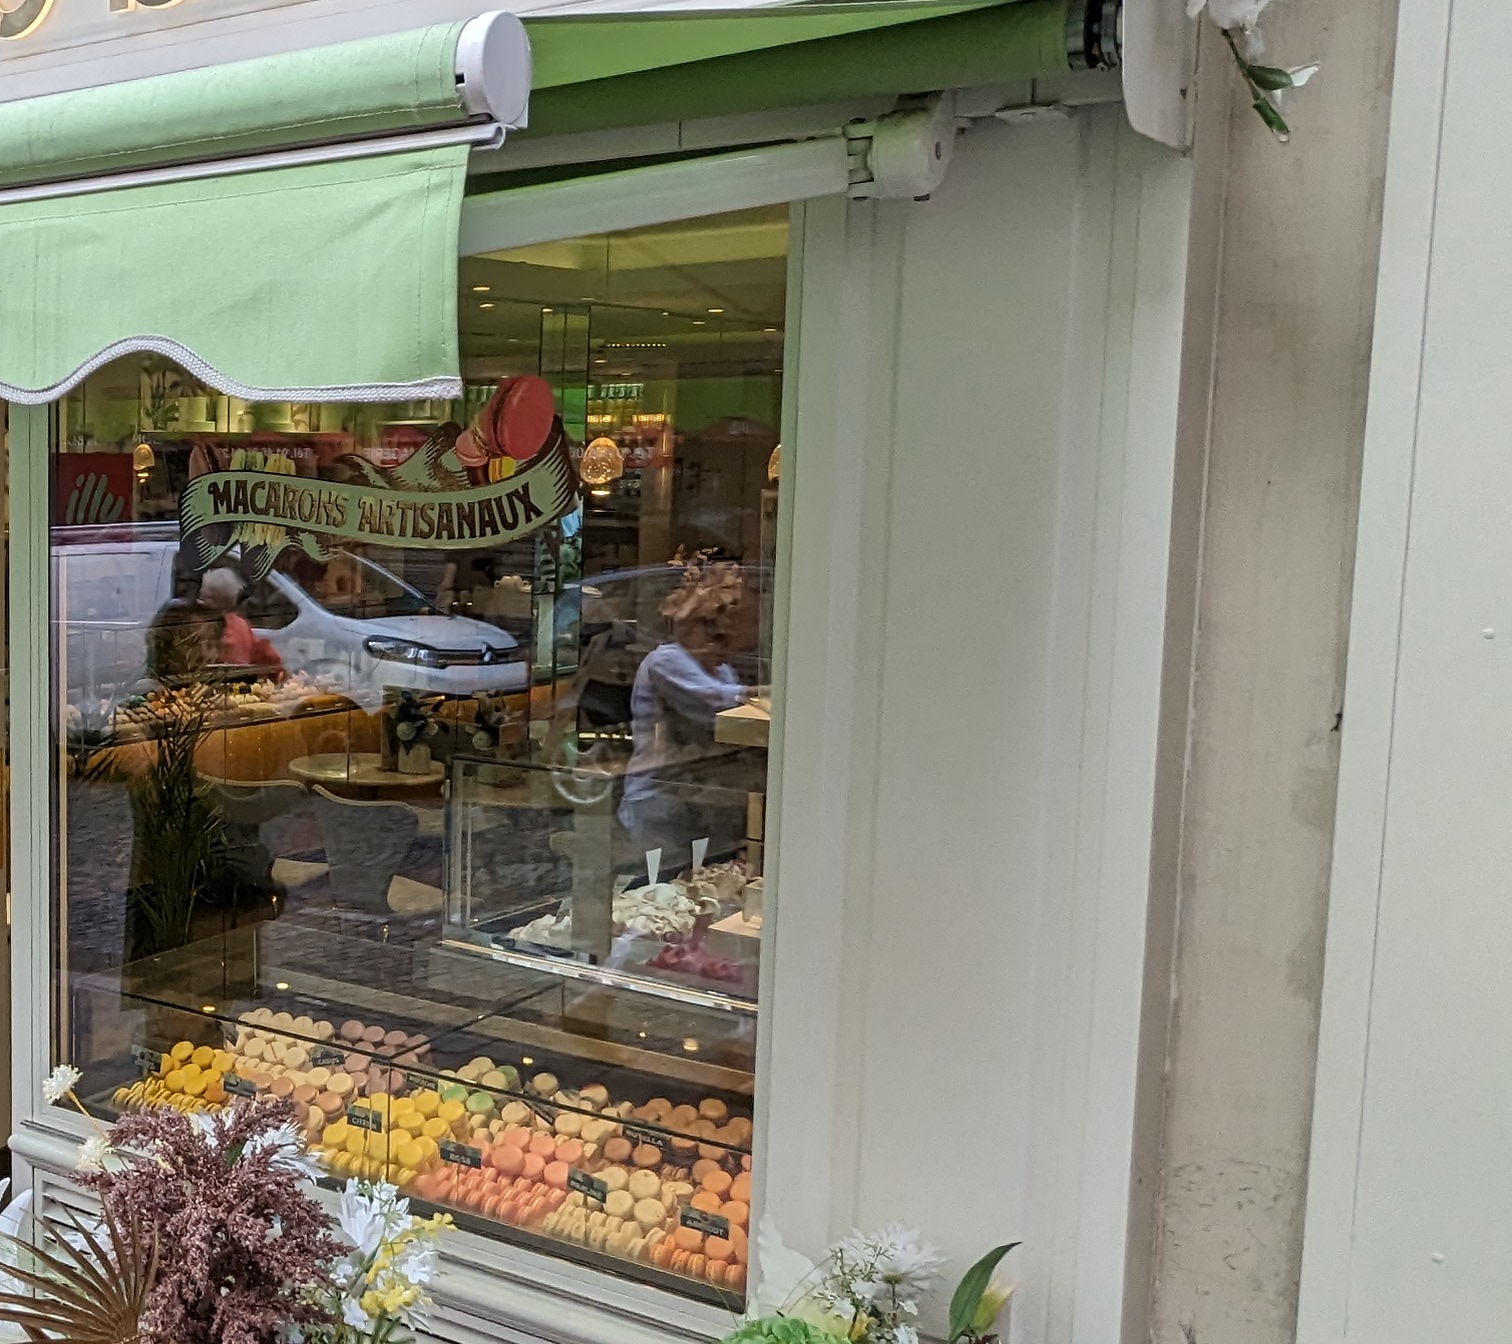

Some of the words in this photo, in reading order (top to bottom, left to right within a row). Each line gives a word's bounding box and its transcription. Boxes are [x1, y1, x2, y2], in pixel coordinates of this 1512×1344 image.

[65, 472, 125, 524] illy
[208, 480, 350, 528] MACARONS
[358, 481, 544, 540] ARTISANAUX
